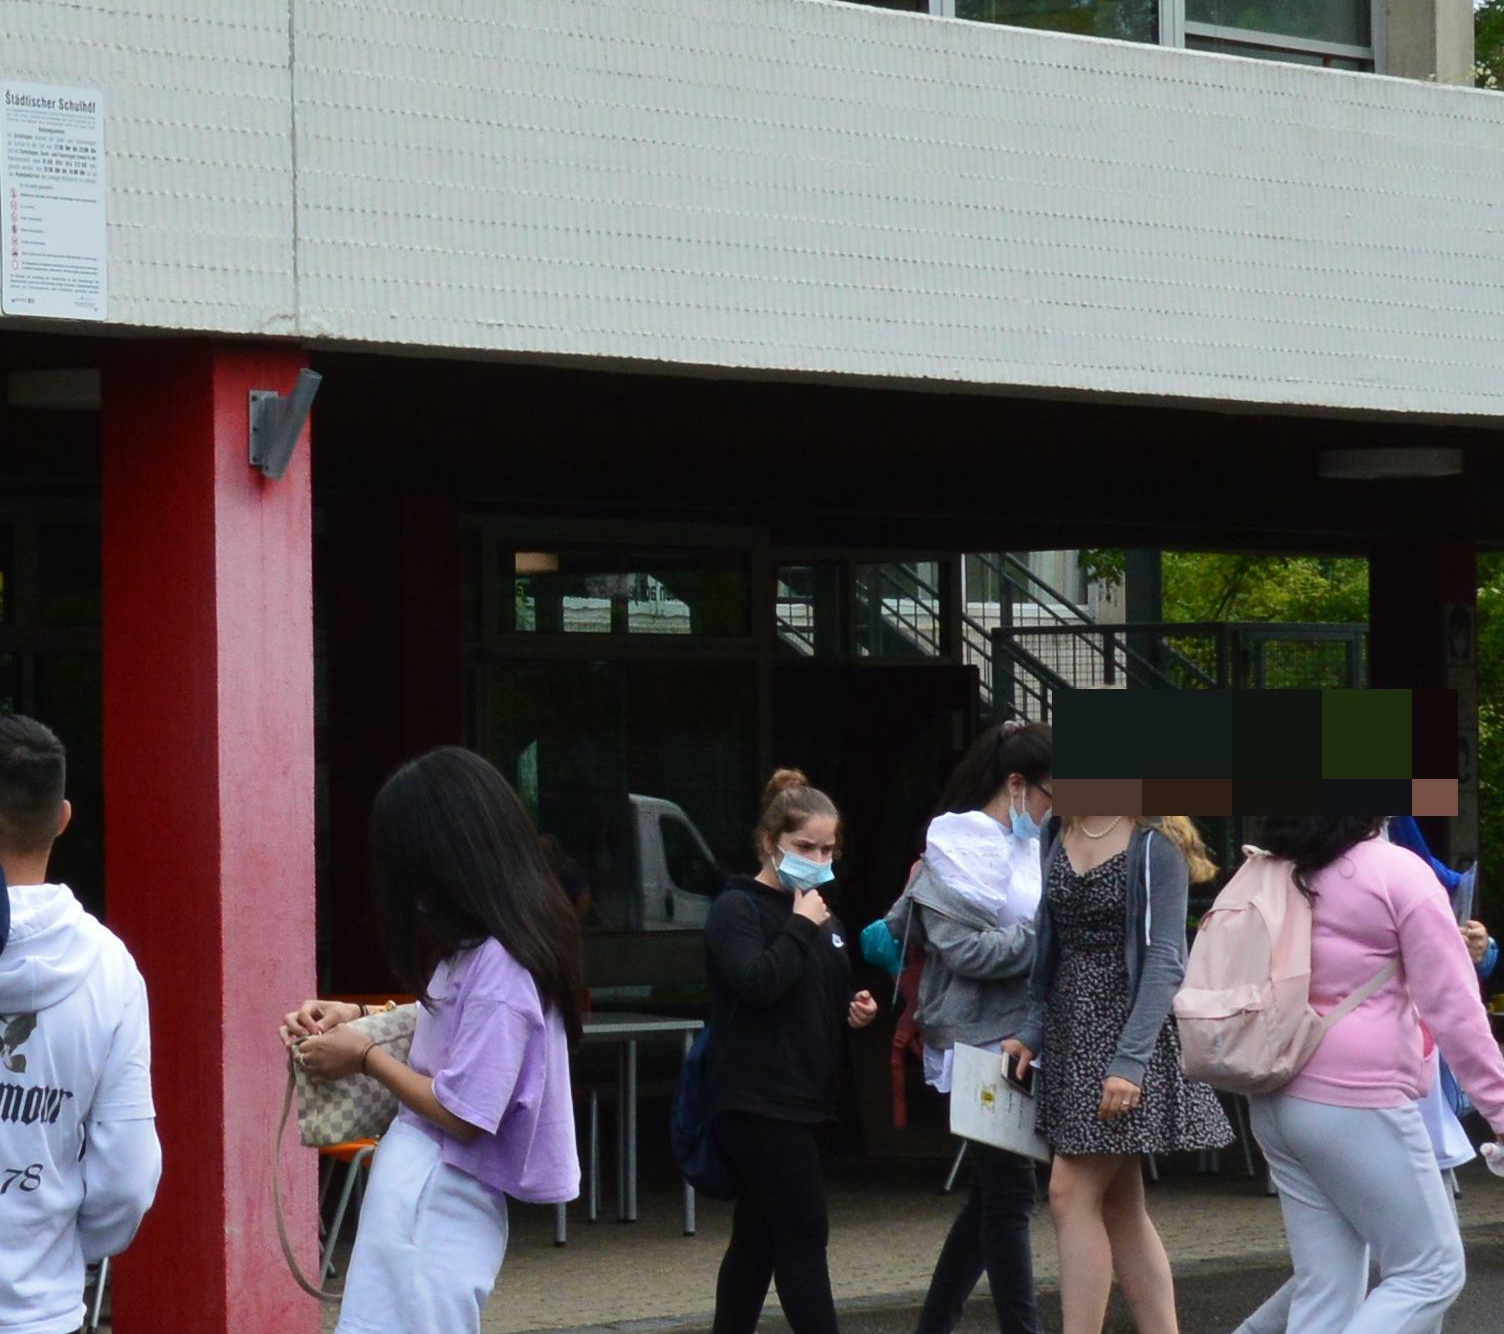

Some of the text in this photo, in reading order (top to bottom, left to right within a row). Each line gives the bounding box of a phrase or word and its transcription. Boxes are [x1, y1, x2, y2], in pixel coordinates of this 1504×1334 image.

[5, 91, 96, 114] Städtischer Schulhof
[0, 1164, 42, 1194] 78
